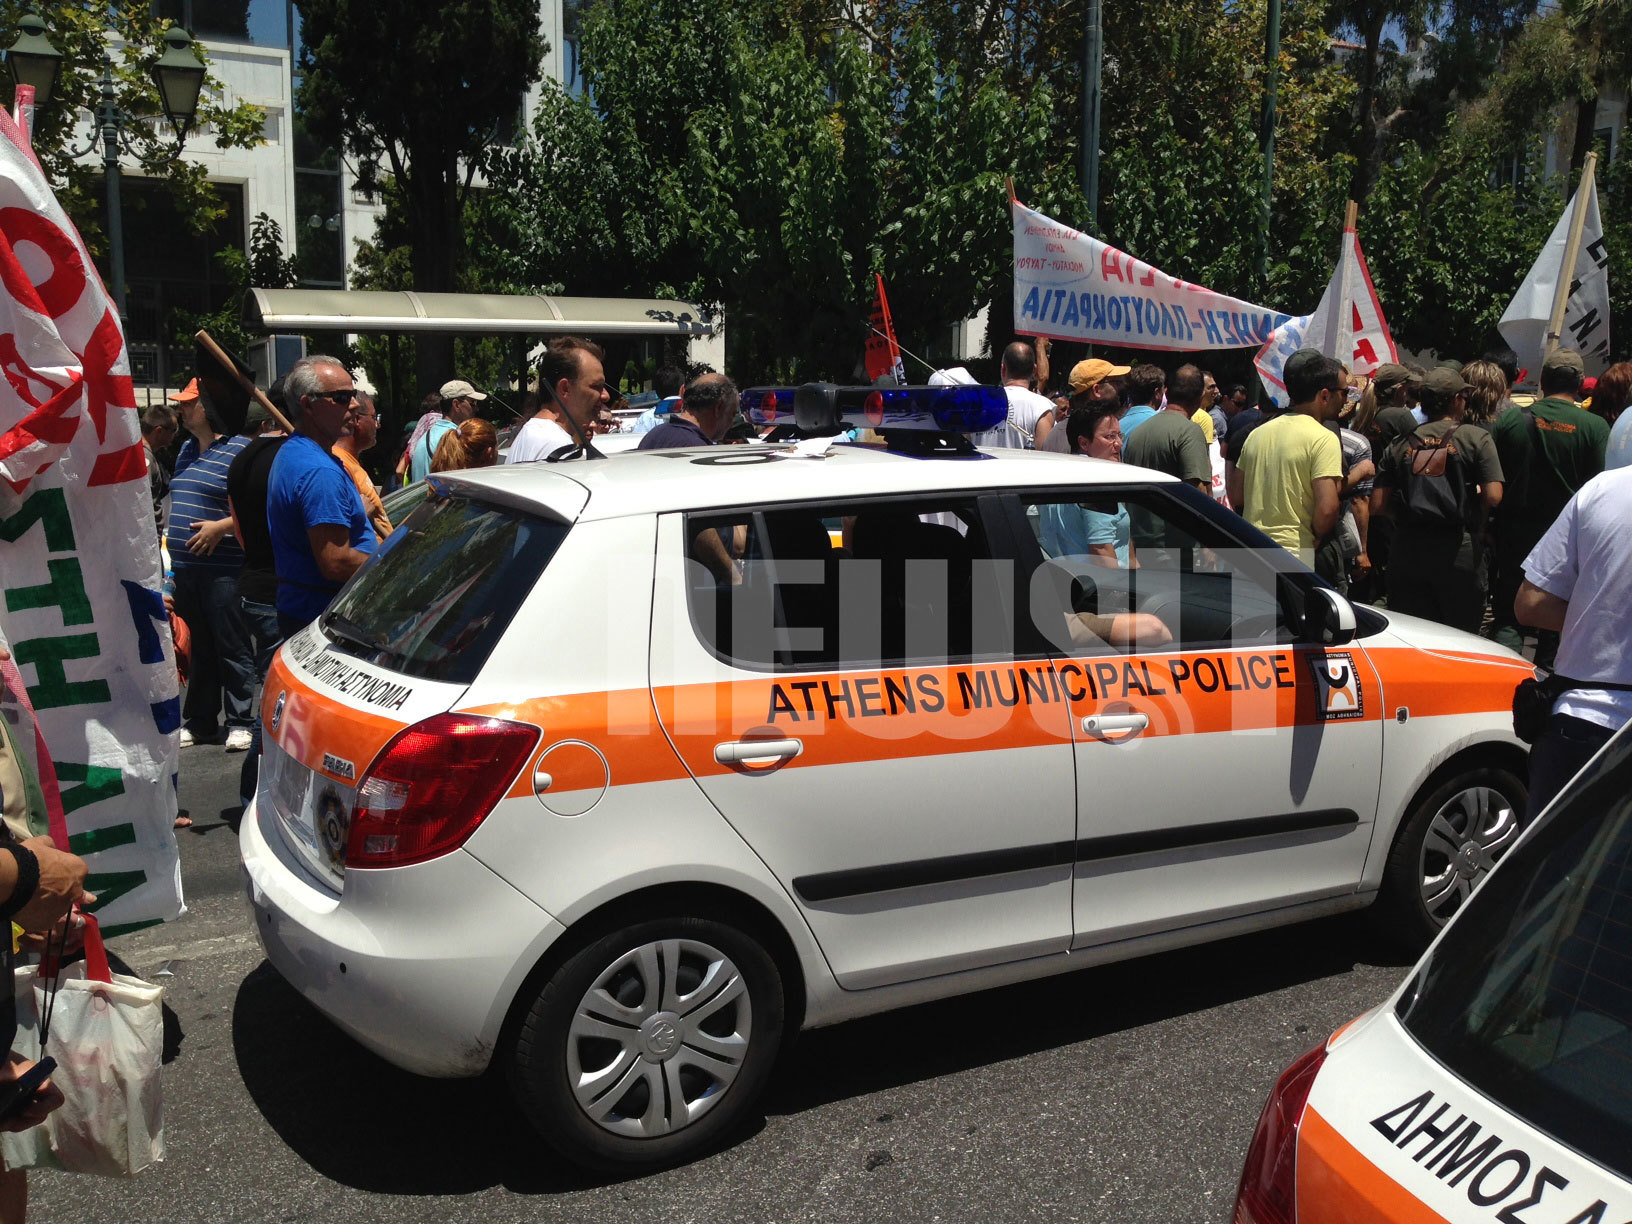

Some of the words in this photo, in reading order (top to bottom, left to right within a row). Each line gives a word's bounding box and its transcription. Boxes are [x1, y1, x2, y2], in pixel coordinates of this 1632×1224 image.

[338, 668, 413, 711] ΑΣΤΥΝΟΜΙΑ
[766, 672, 945, 724] ATHENS
[956, 660, 1166, 710] MUNICIPAL
[1169, 654, 1295, 694] POLICE
[1369, 1090, 1570, 1224] ΔΗΜΟΣ
